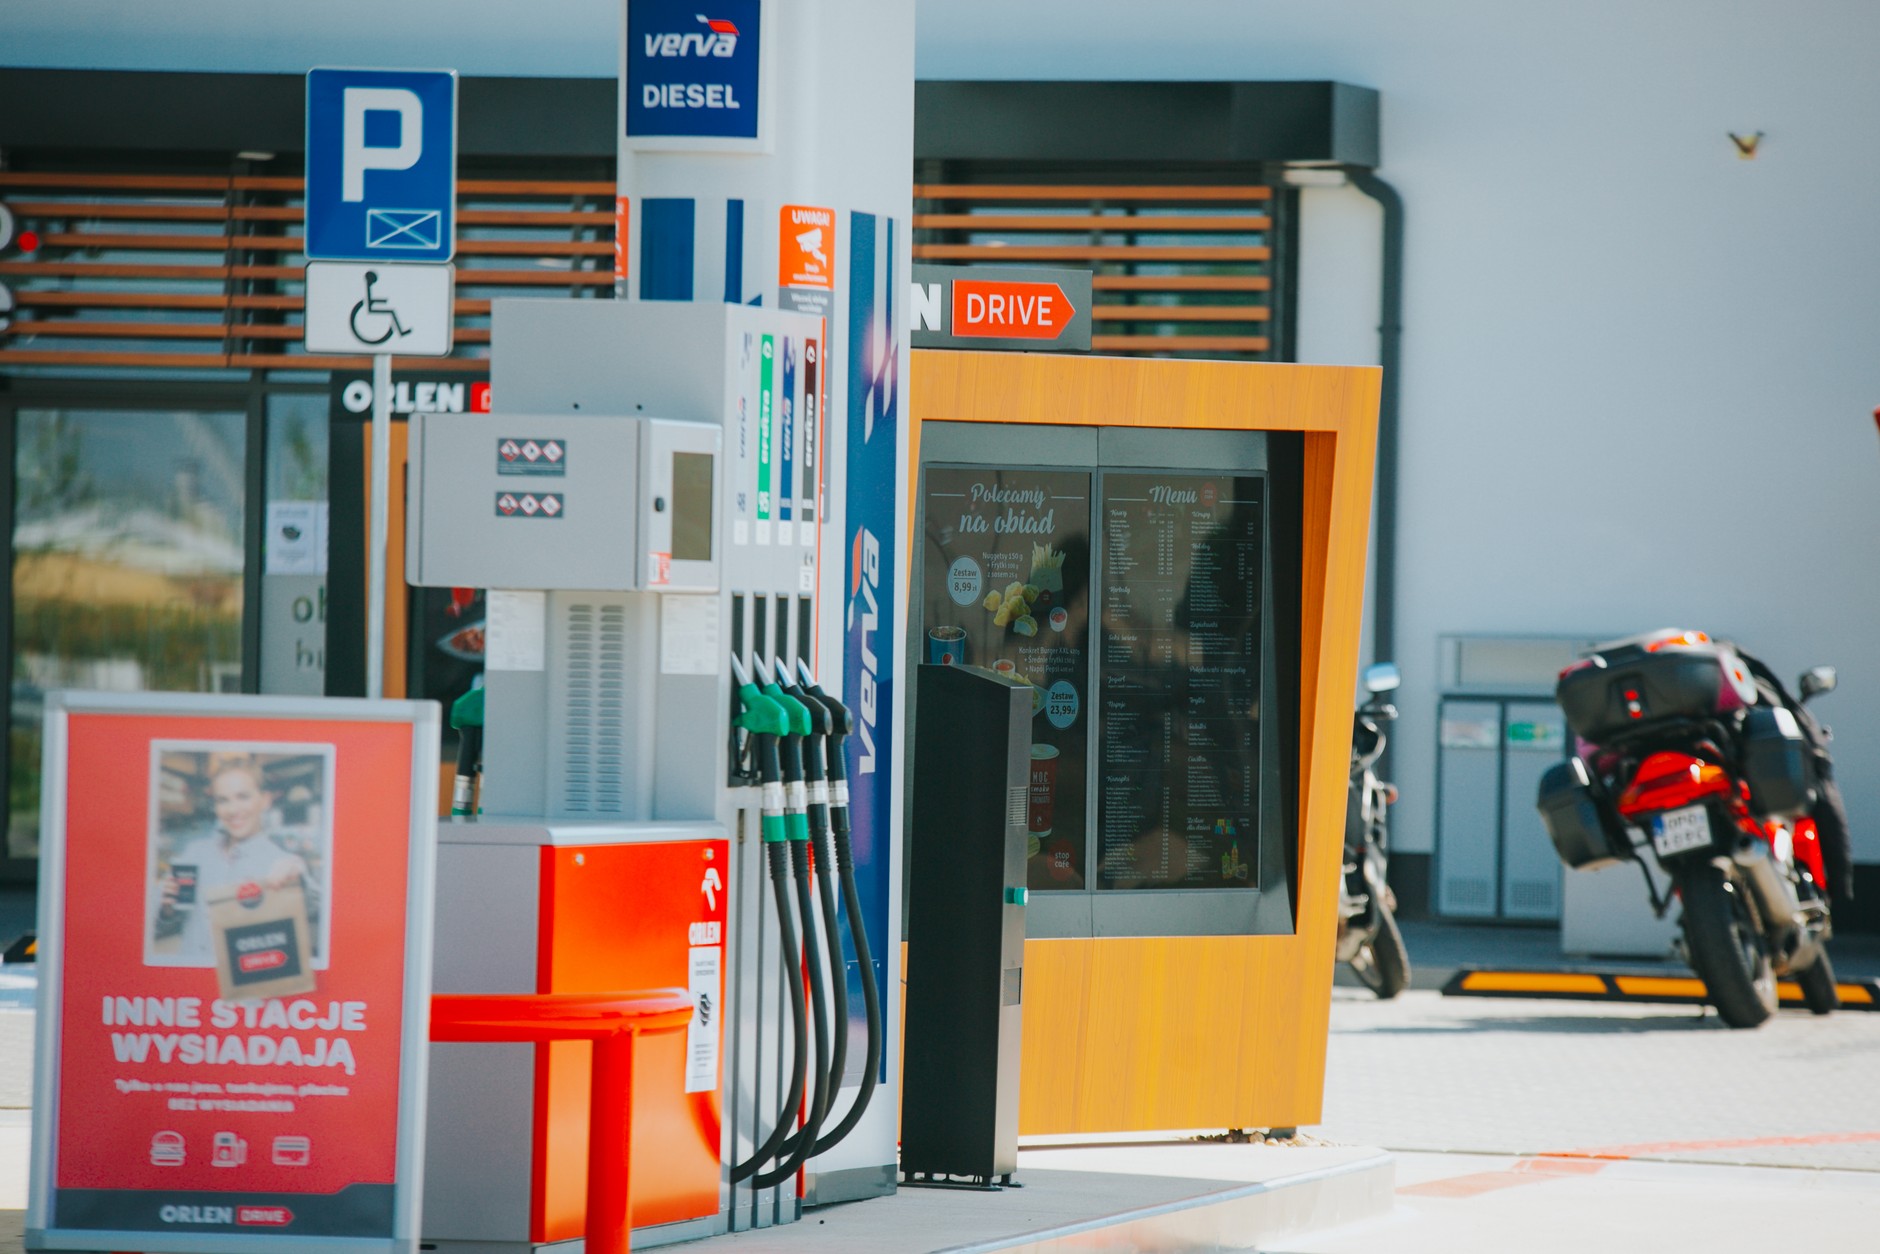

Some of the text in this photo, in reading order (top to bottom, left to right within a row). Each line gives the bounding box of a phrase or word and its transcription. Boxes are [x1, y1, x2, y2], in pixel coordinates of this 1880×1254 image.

[644, 32, 738, 58] verva
[643, 84, 740, 109] DIESEL
[341, 87, 423, 202] P
[967, 293, 1054, 326] DRIVE
[971, 482, 1046, 509] Polecamy
[1149, 485, 1198, 506] Menu
[959, 508, 1055, 534] na obiad
[953, 568, 977, 577] Zestaw
[954, 582, 972, 592] 8,99
[858, 528, 880, 777] verva
[1019, 646, 1040, 655] Konkret
[1040, 647, 1058, 656] Burger
[1051, 691, 1074, 700] Zestaw
[1050, 705, 1071, 716] 23,99
[1032, 771, 1049, 783] MOC
[1054, 859, 1070, 868] cafe
[1055, 851, 1070, 862] stop
[102, 995, 367, 1032] INNE STACJE
[110, 1033, 356, 1076] WYSIADAJĄ
[160, 1205, 232, 1223] ORLEN
